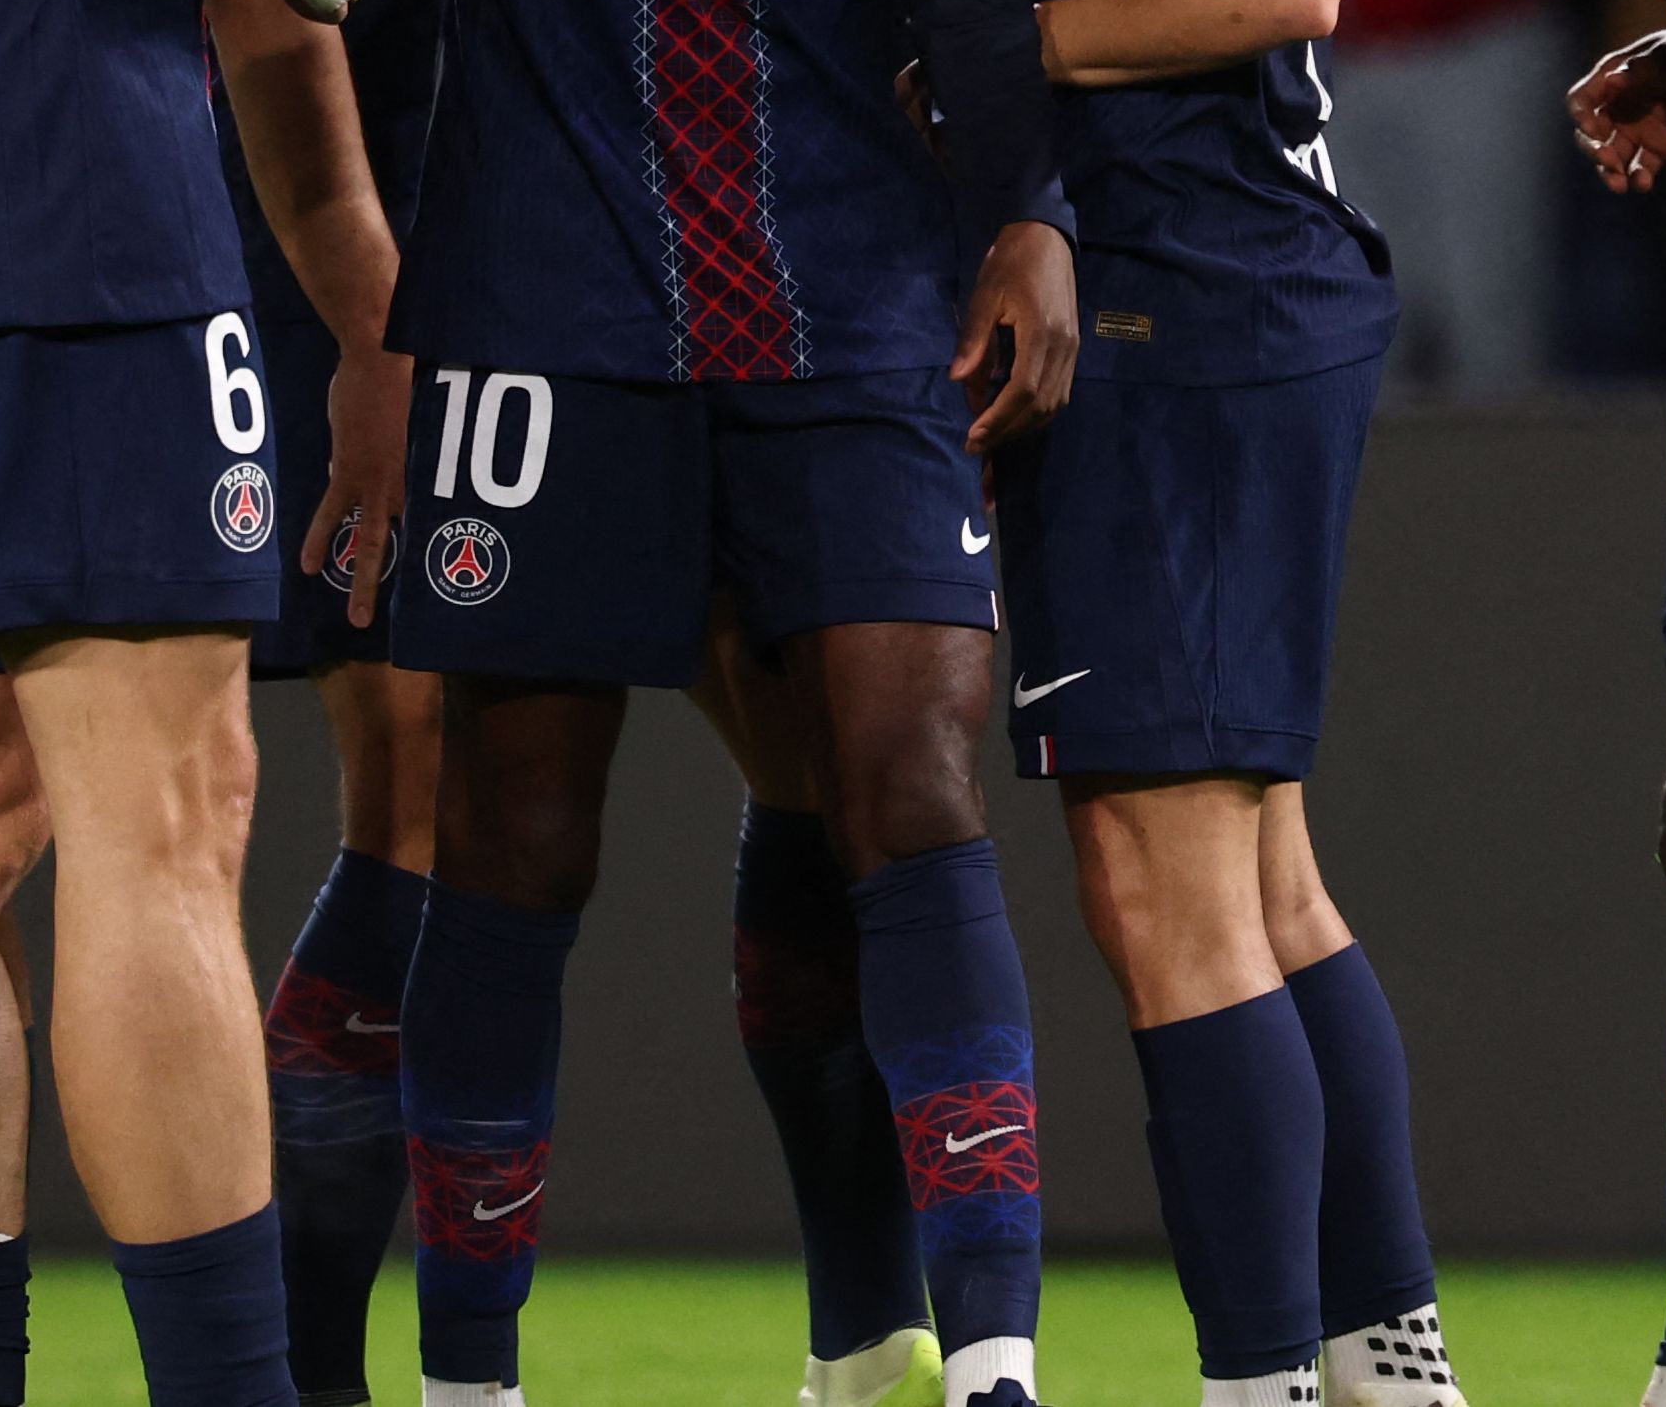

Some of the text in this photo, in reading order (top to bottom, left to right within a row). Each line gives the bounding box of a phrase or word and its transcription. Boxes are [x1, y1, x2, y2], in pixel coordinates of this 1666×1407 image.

[204, 311, 266, 455] 6
[222, 467, 263, 490] PARIS
[433, 368, 554, 509] 10
[442, 522, 498, 547] PARIS
